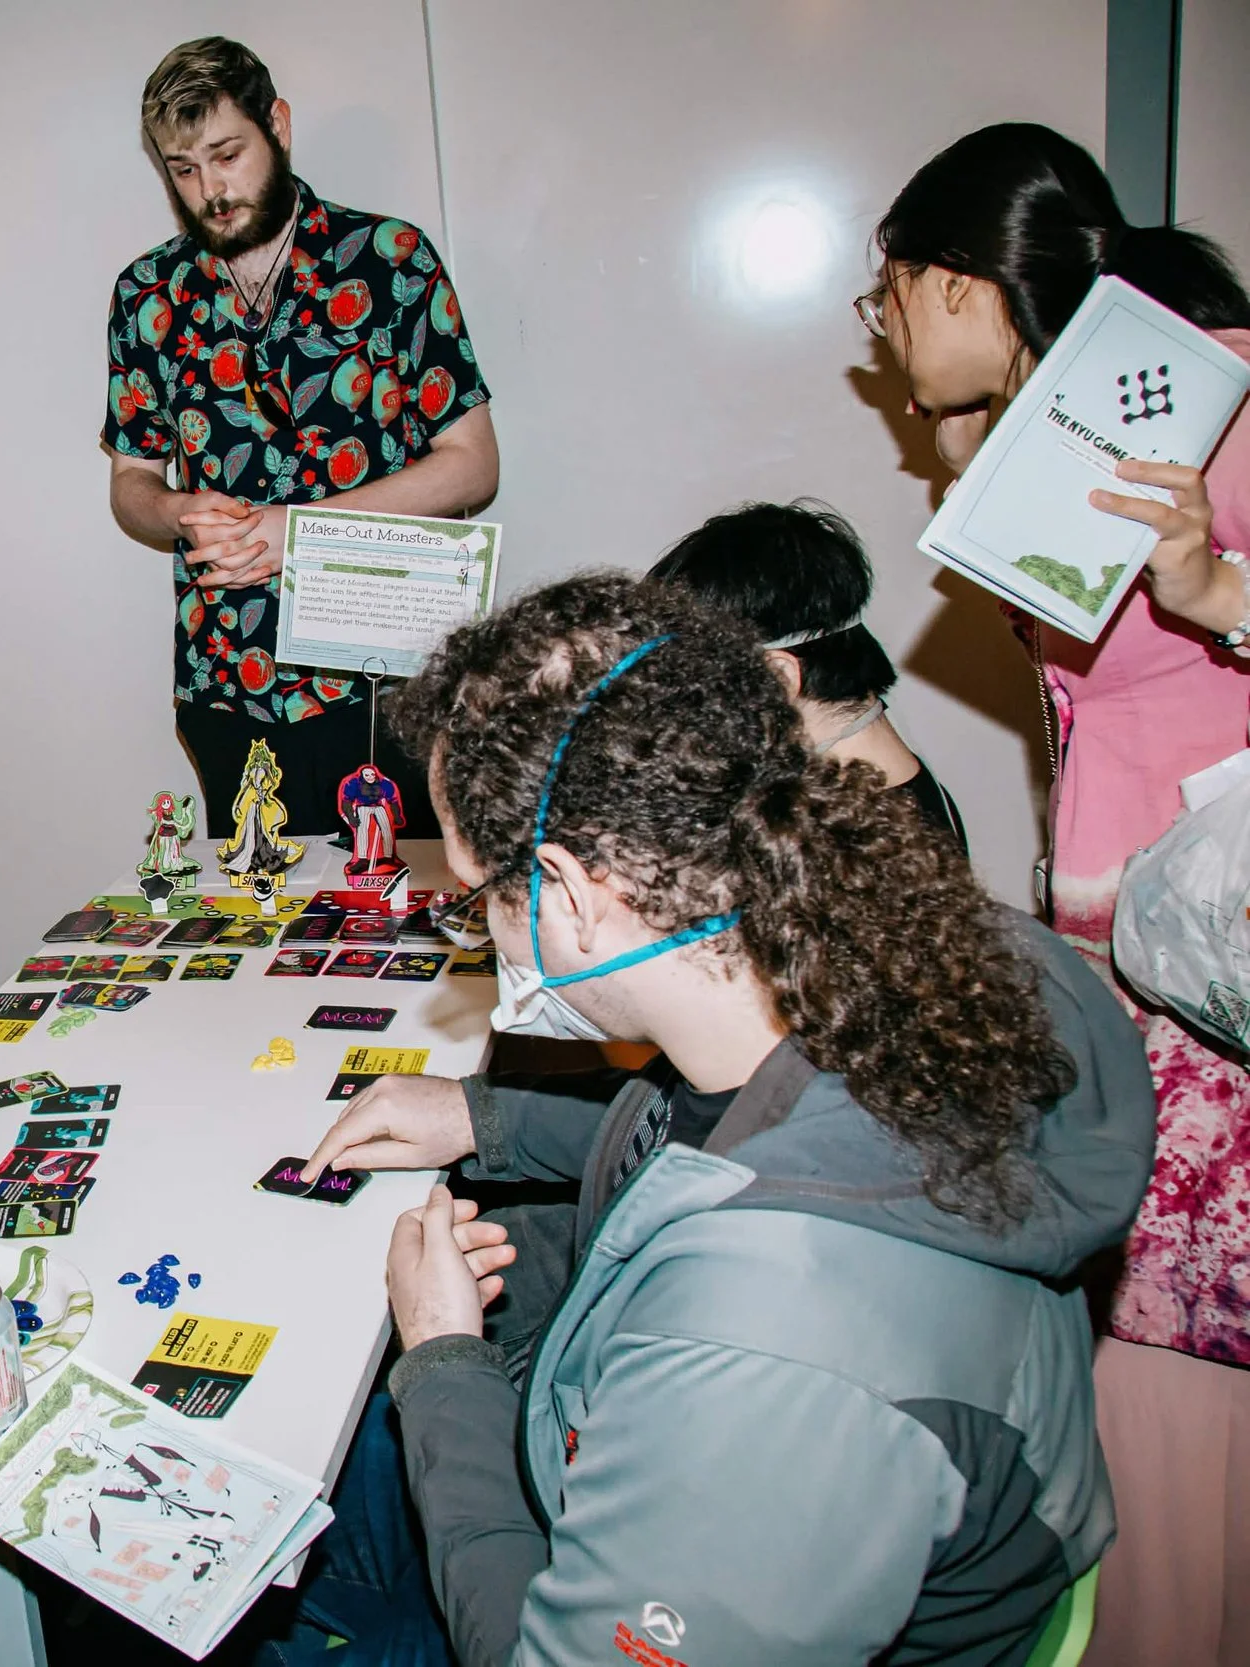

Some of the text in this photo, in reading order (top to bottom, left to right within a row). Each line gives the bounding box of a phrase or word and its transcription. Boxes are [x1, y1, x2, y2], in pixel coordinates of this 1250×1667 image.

[1046, 407, 1071, 427] THE
[1067, 419, 1096, 442] NYU
[1092, 436, 1129, 462] GAME
[301, 521, 444, 546] Make-Out Monsters
[384, 583, 410, 592] players
[299, 595, 332, 604] monsters
